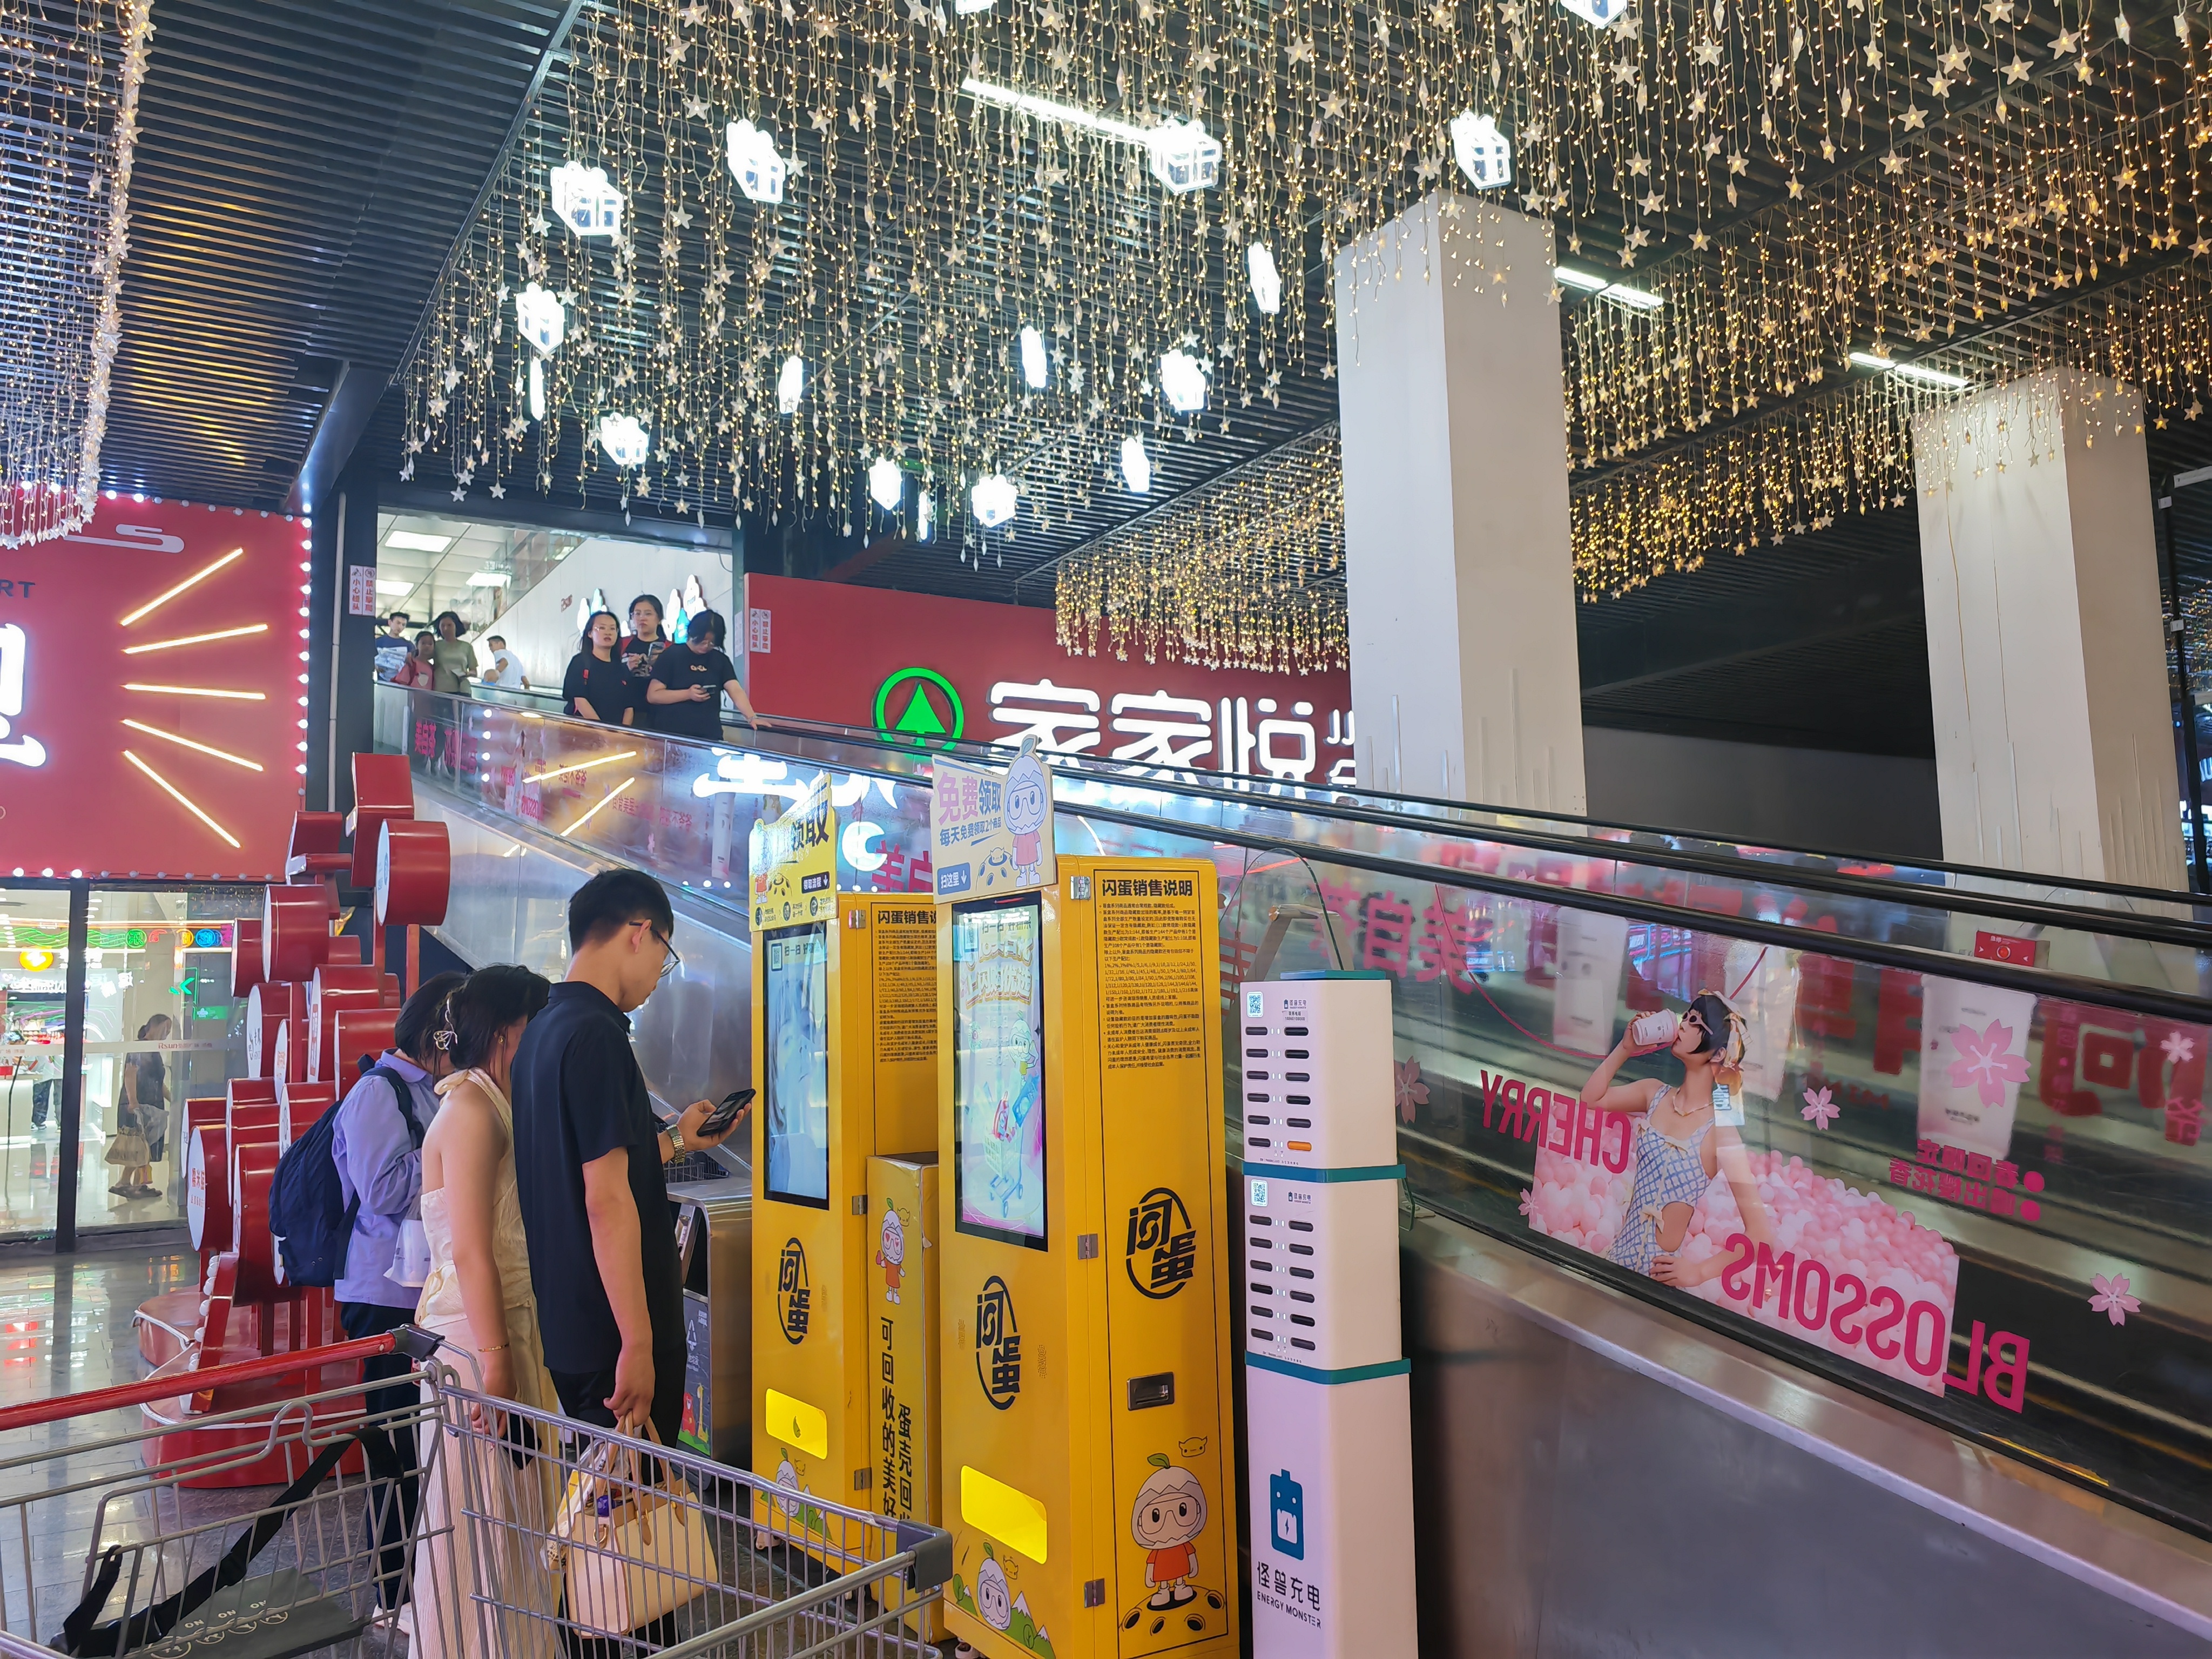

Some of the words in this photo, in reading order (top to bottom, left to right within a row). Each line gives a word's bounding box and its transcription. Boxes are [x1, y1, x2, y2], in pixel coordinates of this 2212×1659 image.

[989, 678, 1317, 792] 家家悦
[936, 771, 1002, 826] 免费领取
[939, 817, 1002, 847] 每天免费领取2个商品
[803, 876, 822, 890] 领取流程
[941, 872, 960, 889] 扫这里
[1102, 879, 1193, 897] 闪蛋销售说明
[880, 1316, 896, 1520] 可回收的美好
[1257, 1561, 1320, 1611] 怪兽充电
[1257, 1590, 1284, 1612] ENERGY
[1286, 1606, 1321, 1630] MONSTER
